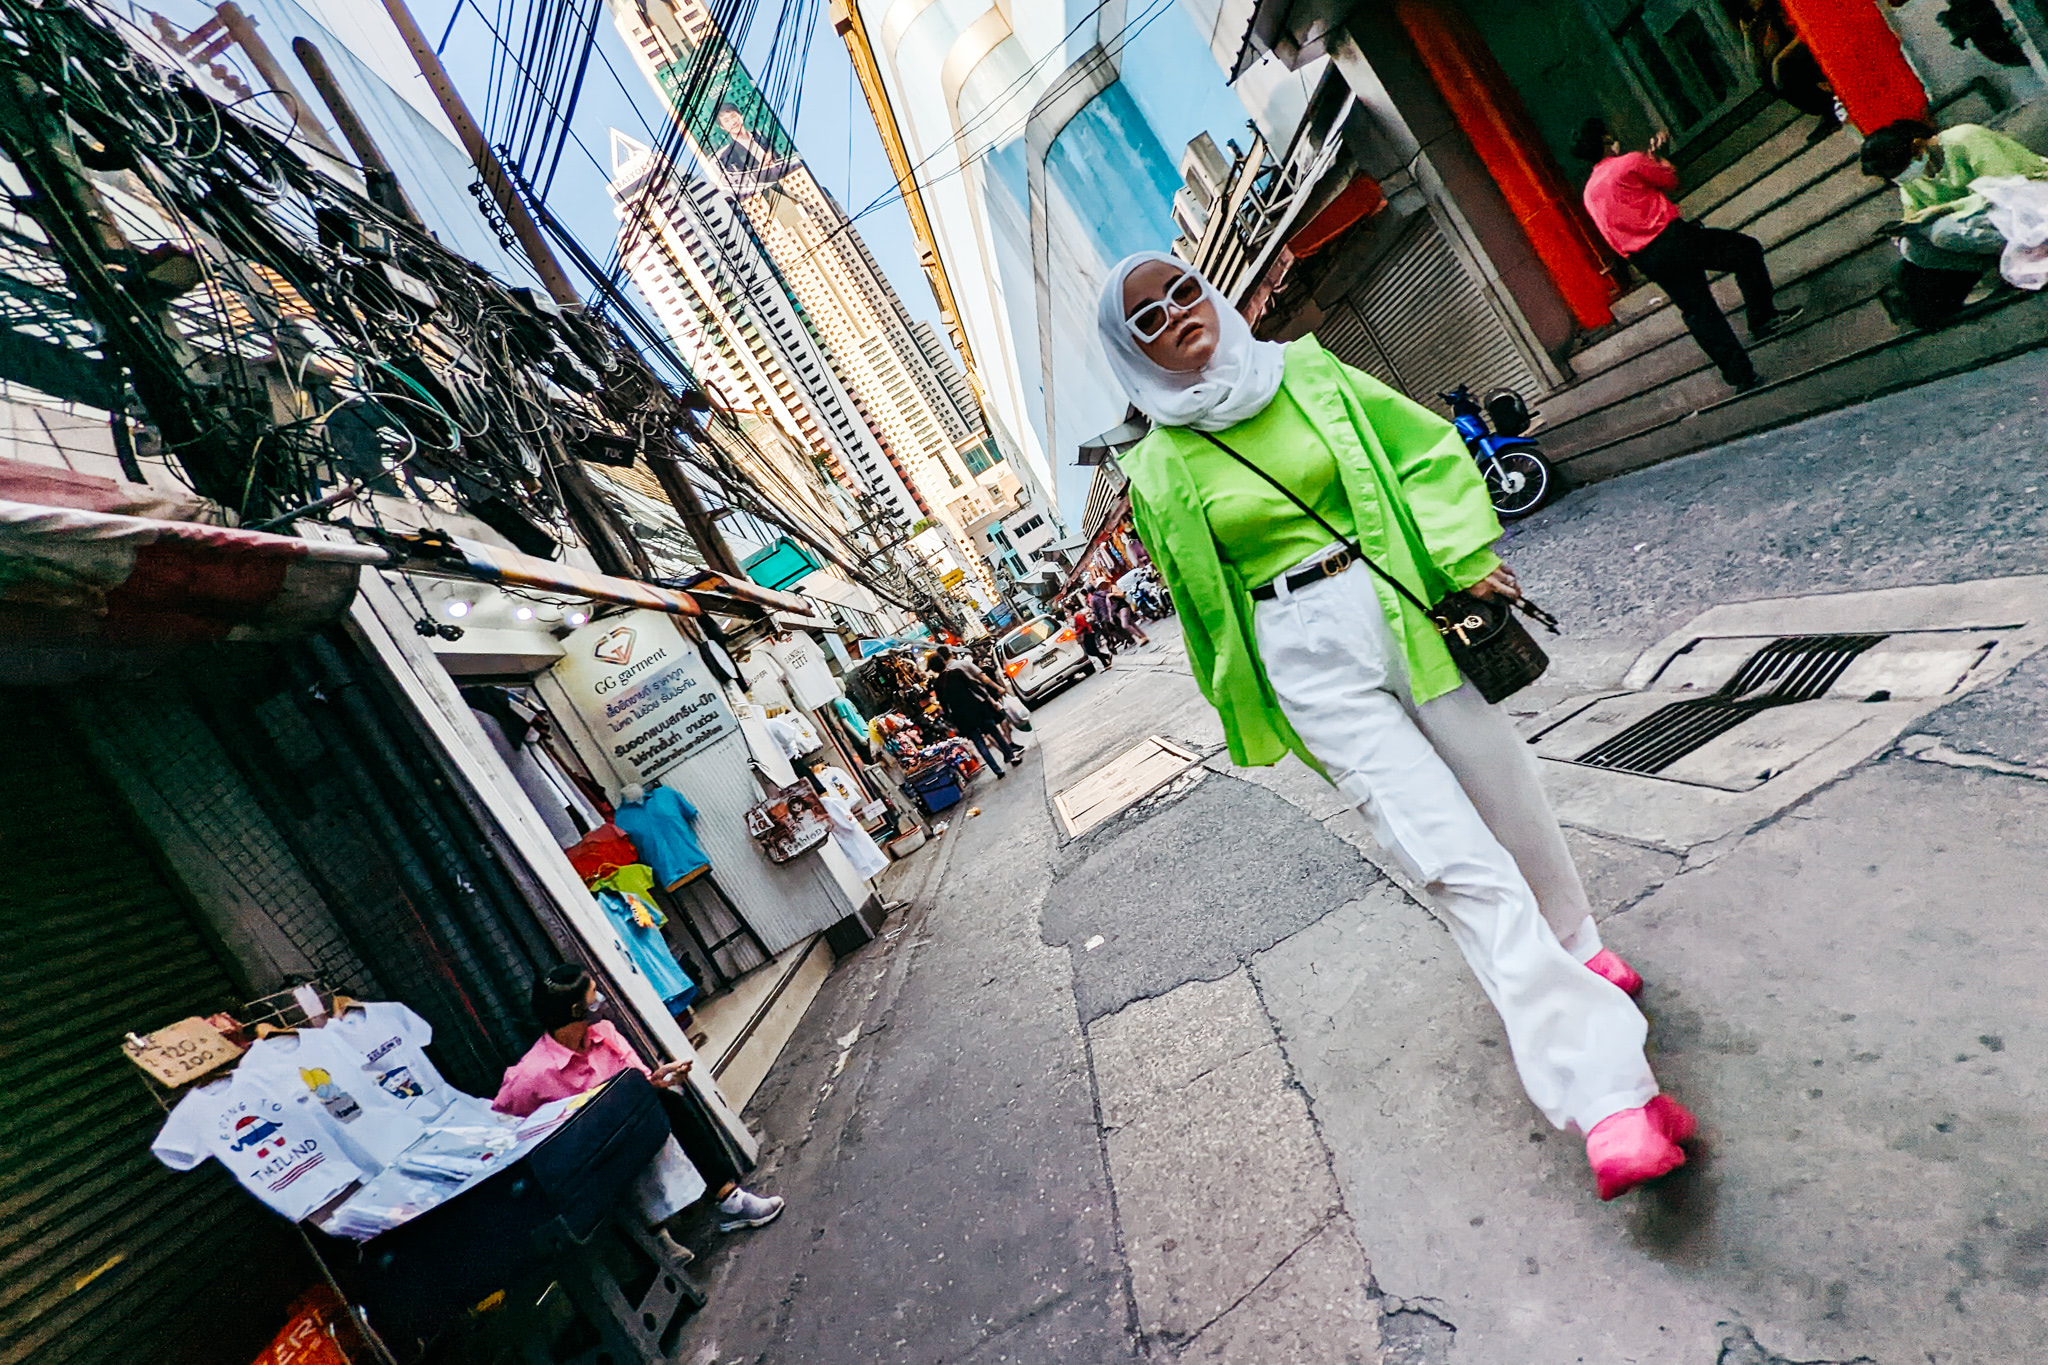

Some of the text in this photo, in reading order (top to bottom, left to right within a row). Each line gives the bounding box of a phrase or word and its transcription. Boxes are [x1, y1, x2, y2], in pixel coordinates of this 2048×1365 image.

[594, 647, 667, 695] GG garment
[261, 1098, 282, 1112] TO
